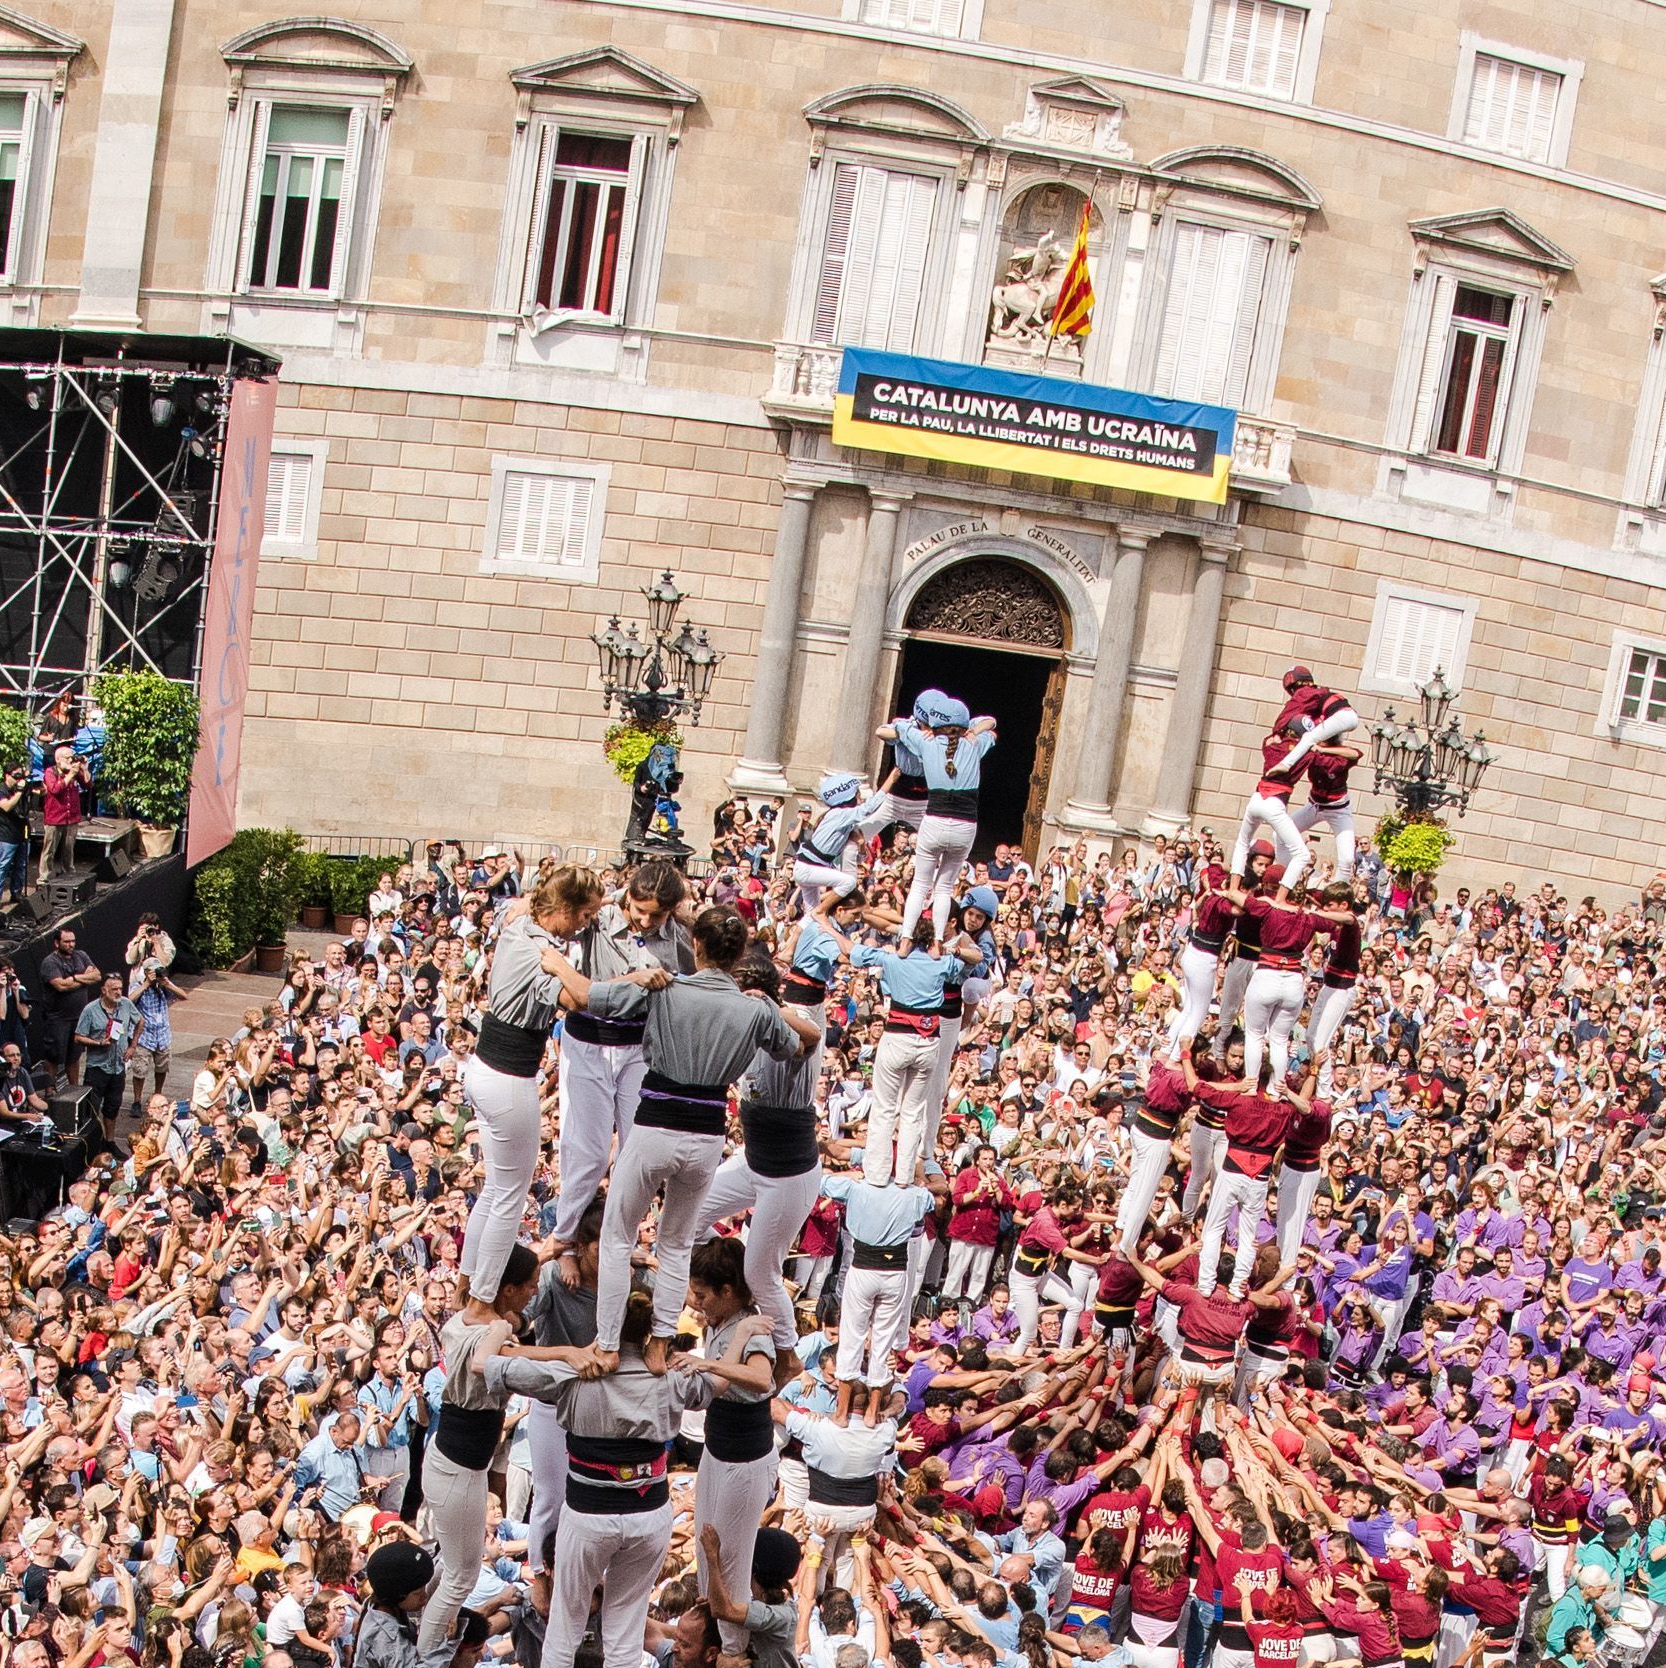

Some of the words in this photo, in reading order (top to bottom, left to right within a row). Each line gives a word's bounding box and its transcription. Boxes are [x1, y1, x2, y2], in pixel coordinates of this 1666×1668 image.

[870, 408, 898, 422] PER
[901, 412, 919, 426] LA
[922, 416, 954, 433] PAU,
[957, 421, 975, 435] LA
[978, 424, 1052, 446] LLIBERTAT
[1055, 436, 1060, 448] I
[1062, 438, 1087, 452] ELS
[1090, 443, 1133, 460] DRETS
[1136, 451, 1196, 470] HUMANS
[874, 383, 1020, 423] CATALUNYA
[1026, 407, 1081, 433] AMB
[1087, 416, 1197, 452] UCRAÏNA
[907, 531, 947, 561] PALAU
[950, 524, 968, 537] DE
[972, 522, 989, 533] LA
[1027, 528, 1096, 583] GENERALITAT
[1098, 1576, 1114, 1590] DE
[1259, 1638, 1287, 1651] JOVE
